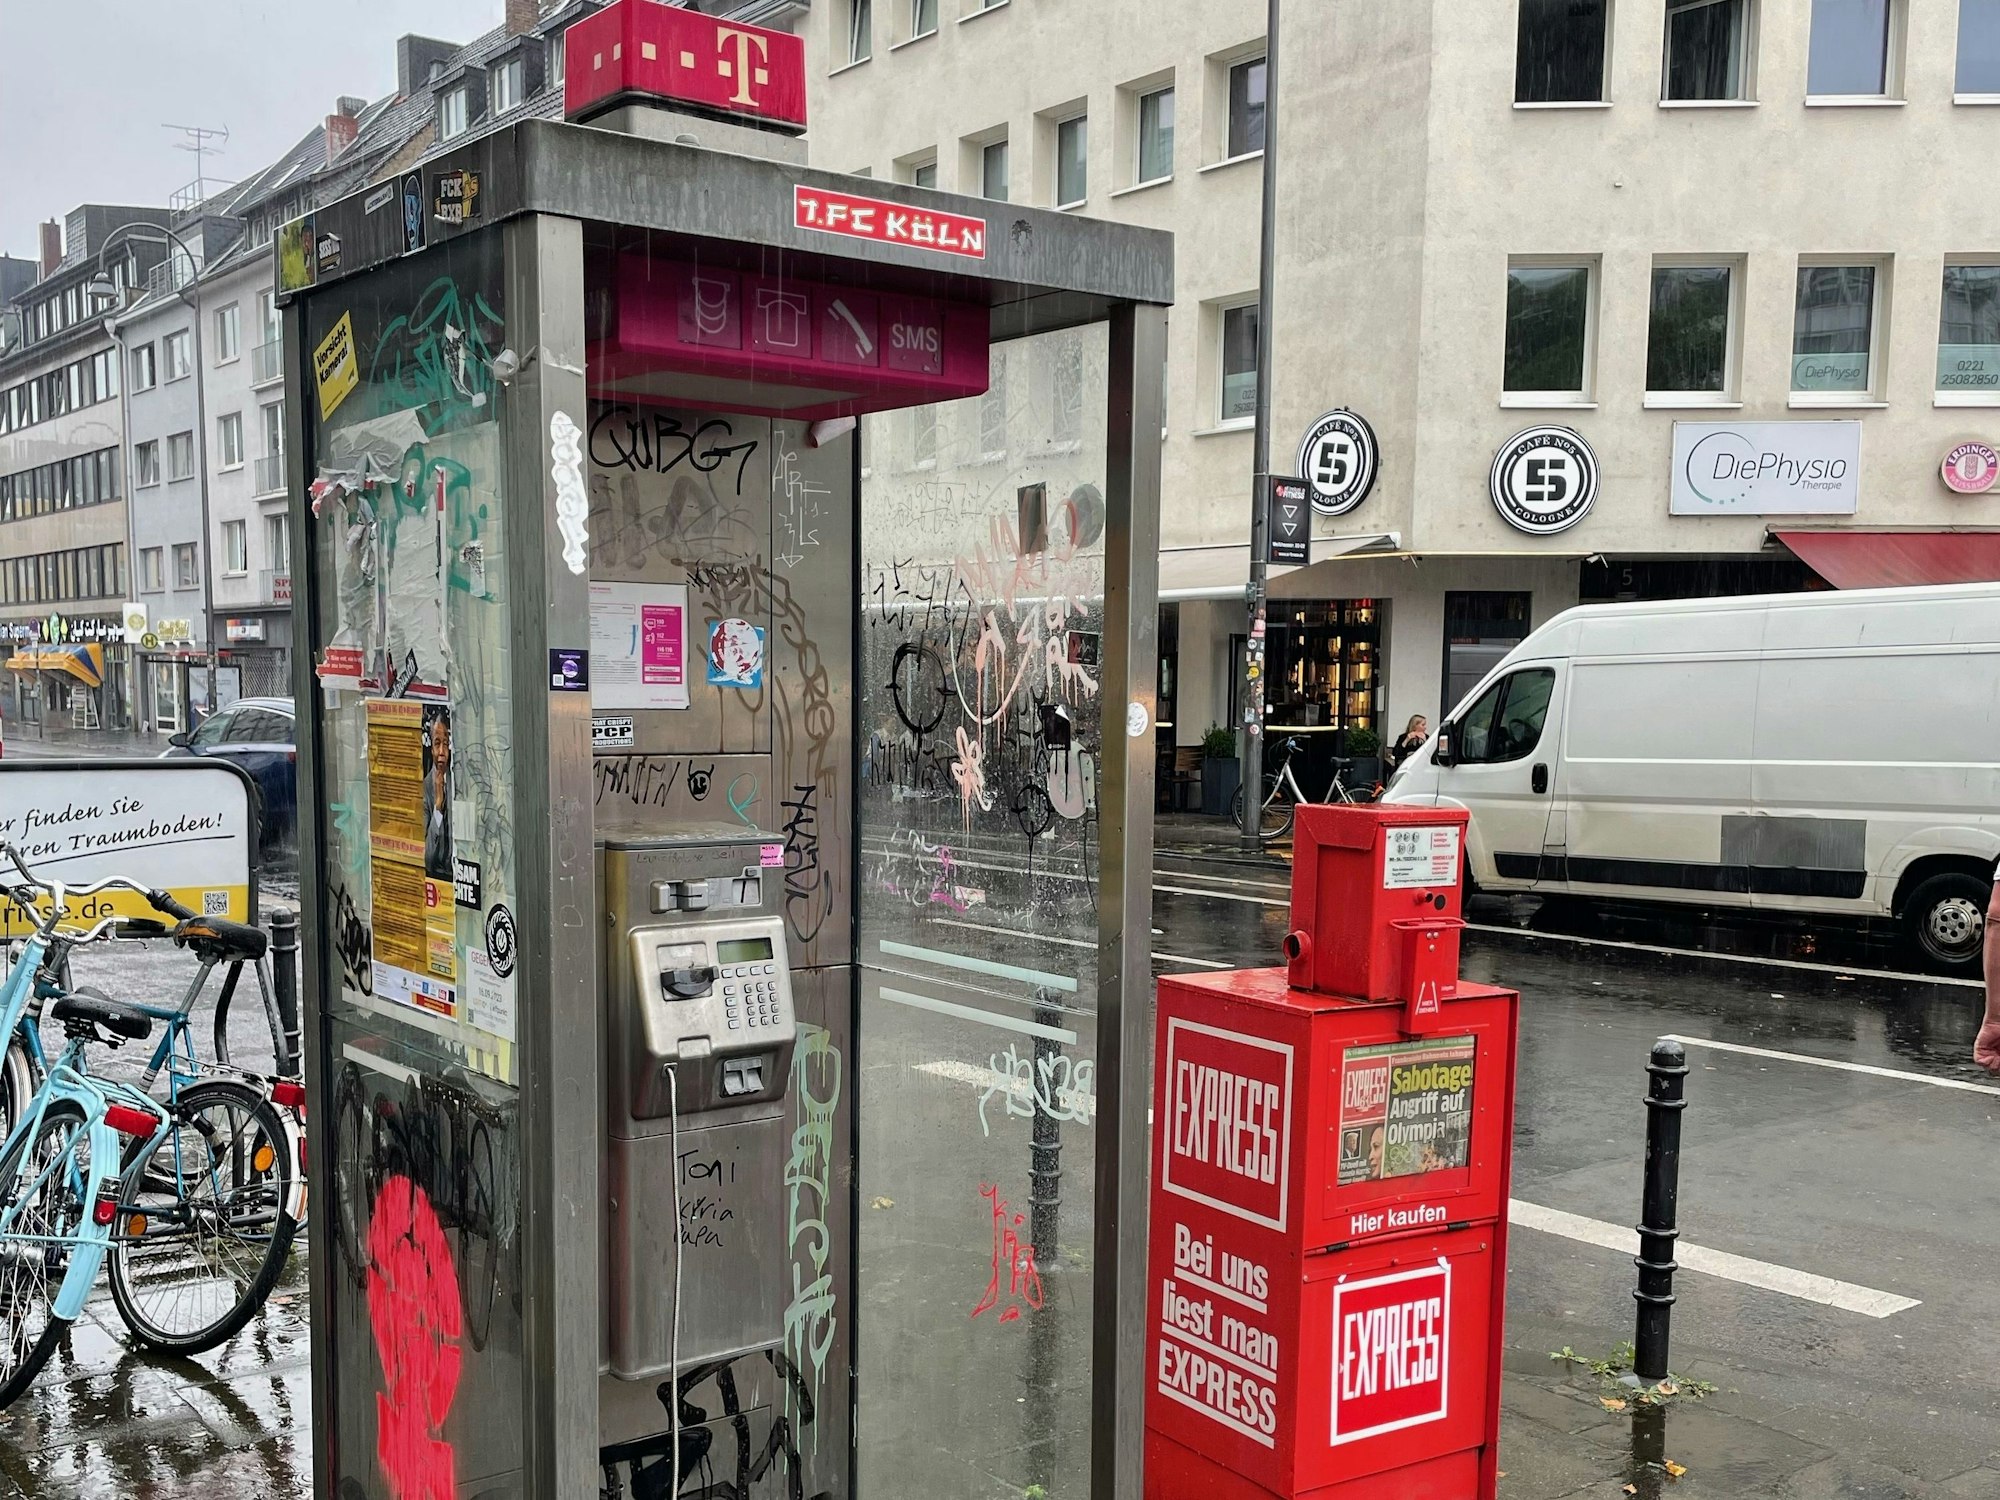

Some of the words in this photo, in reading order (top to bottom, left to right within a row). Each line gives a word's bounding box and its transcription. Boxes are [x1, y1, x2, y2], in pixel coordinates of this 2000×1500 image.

[441, 178, 463, 198] FCK
[886, 214, 982, 251] KÖLN
[317, 323, 347, 368] Vorsicht
[892, 322, 939, 353] SMS
[320, 341, 348, 386] Kamera!
[1805, 365, 1861, 381] DiePhysio
[1957, 360, 1985, 371] 0221
[1242, 388, 1256, 400] 022
[1941, 373, 1999, 385] 25082850
[1517, 434, 1551, 455] CAFÉ
[1948, 444, 1996, 465] ERDINGER
[1713, 452, 1847, 486] DiePhysio
[1312, 488, 1350, 504] OLOGNE
[1801, 480, 1842, 491] Therapie
[1515, 506, 1574, 523] COLOGNE
[1622, 568, 1634, 586] 5
[146, 637, 154, 646] H
[592, 726, 632, 738] PCP
[607, 718, 631, 726] CRISPY
[21, 803, 103, 840] finden
[110, 796, 144, 816] Sie
[69, 813, 222, 850] Traumboden!
[1344, 1067, 1388, 1109] EXPRESS
[1389, 1091, 1439, 1119] Angriff
[1440, 1088, 1466, 1113] auf
[1174, 1059, 1280, 1185] EXPRESS
[1387, 1117, 1446, 1147] Olympia
[678, 1146, 740, 1187] Toni
[1350, 1214, 1385, 1235] Hier
[1387, 1205, 1447, 1228] kaufen
[1174, 1223, 1214, 1278] Bei
[1221, 1251, 1269, 1300] uns
[1162, 1279, 1214, 1341] liest
[1221, 1311, 1279, 1372] man
[1341, 1297, 1441, 1402] EXPRESS
[1158, 1339, 1278, 1436] EXPRESS
